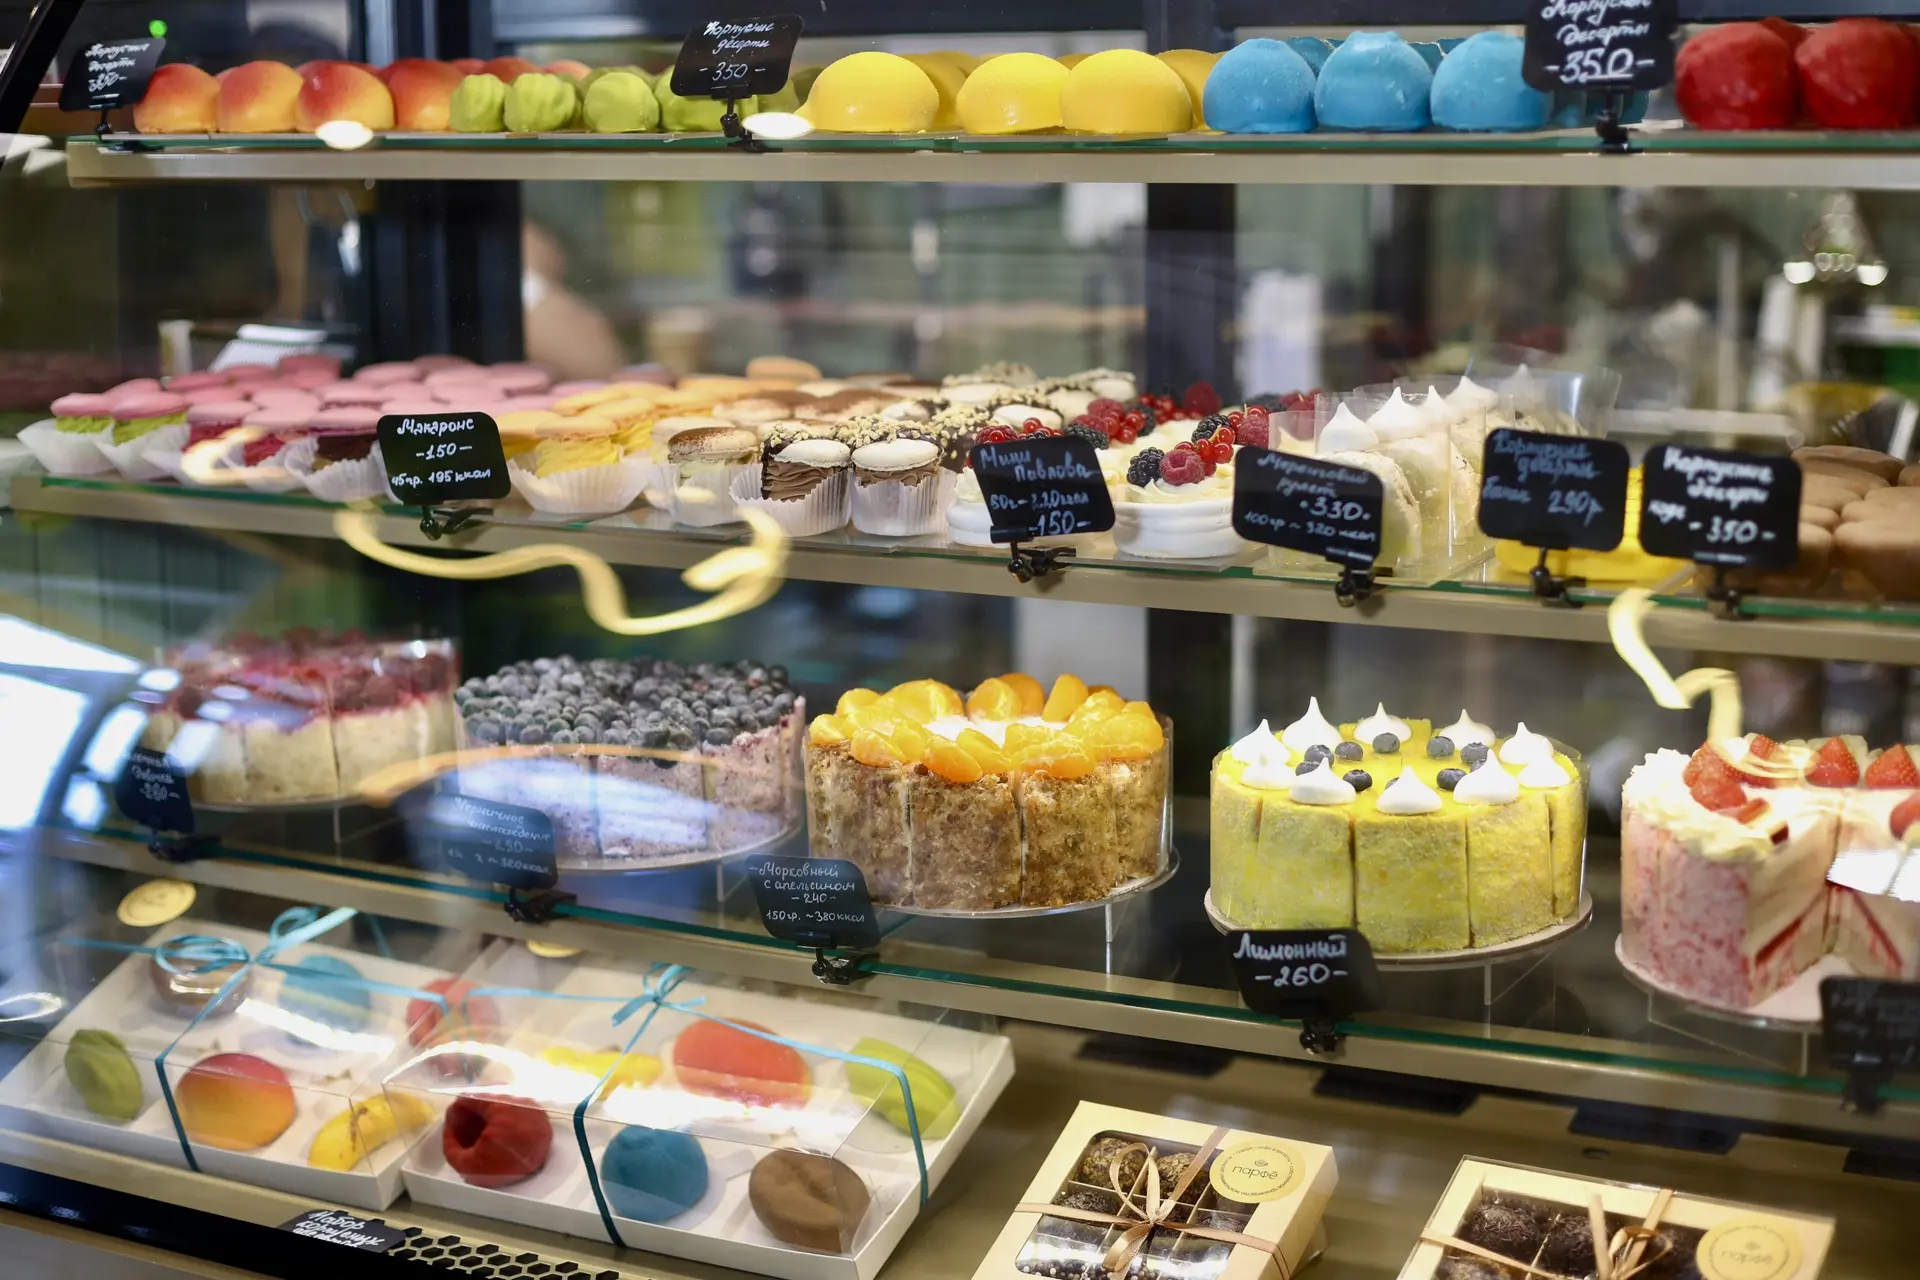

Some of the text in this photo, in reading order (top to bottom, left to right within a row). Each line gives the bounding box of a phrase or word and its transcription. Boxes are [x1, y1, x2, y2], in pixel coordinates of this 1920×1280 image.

[396, 418, 475, 437] Макаронс
[979, 445, 1032, 470] Мини
[1014, 451, 1093, 482] Павлова
[428, 469, 454, 484] 195
[455, 468, 491, 483] ккал
[774, 881, 855, 892] апельсином
[1233, 932, 1348, 961] Лимонный
